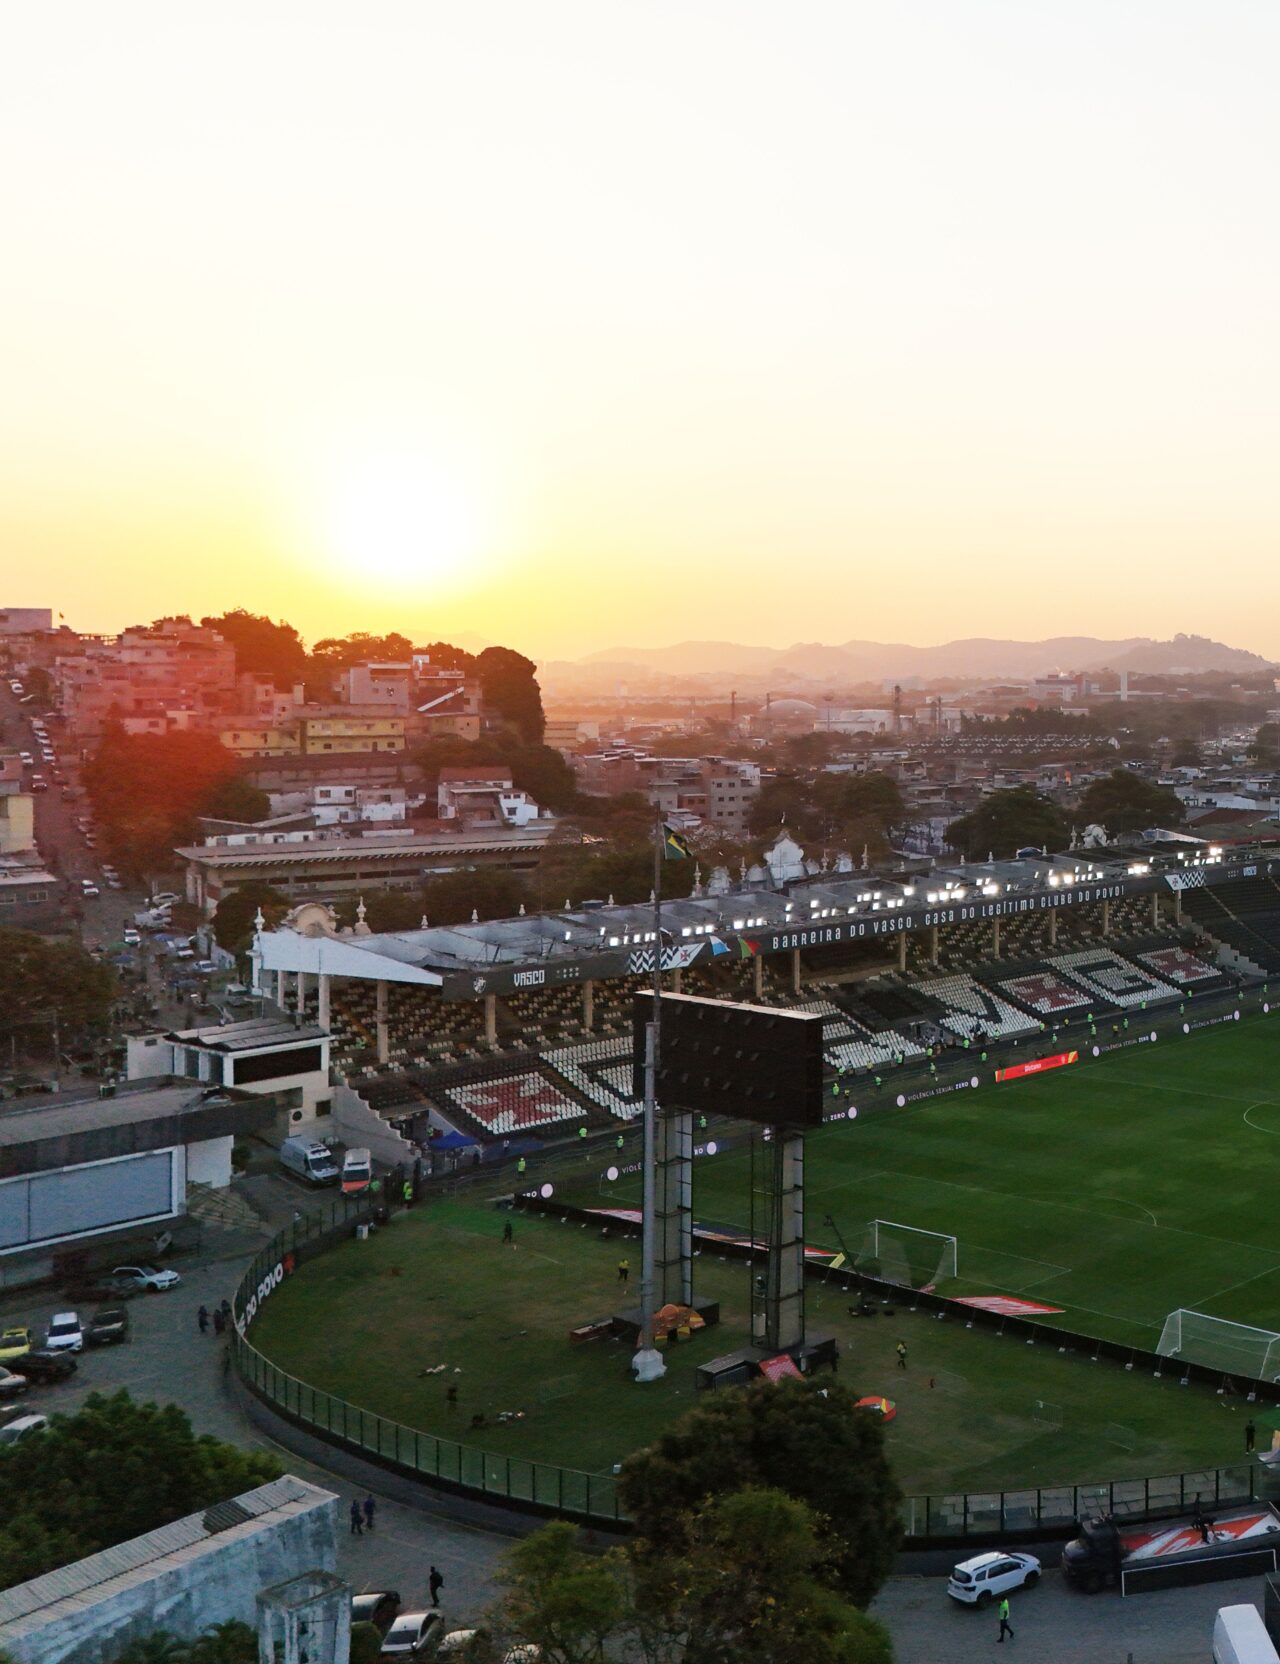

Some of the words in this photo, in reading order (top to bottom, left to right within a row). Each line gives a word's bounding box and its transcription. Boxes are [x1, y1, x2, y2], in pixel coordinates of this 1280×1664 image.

[513, 969, 545, 987] VASCO
[955, 1081, 969, 1089] ZERO
[830, 1112, 845, 1121] ZERO
[621, 1161, 642, 1174] VIOLÊ
[246, 1294, 257, 1325] DO
[257, 1262, 284, 1305] POVO
